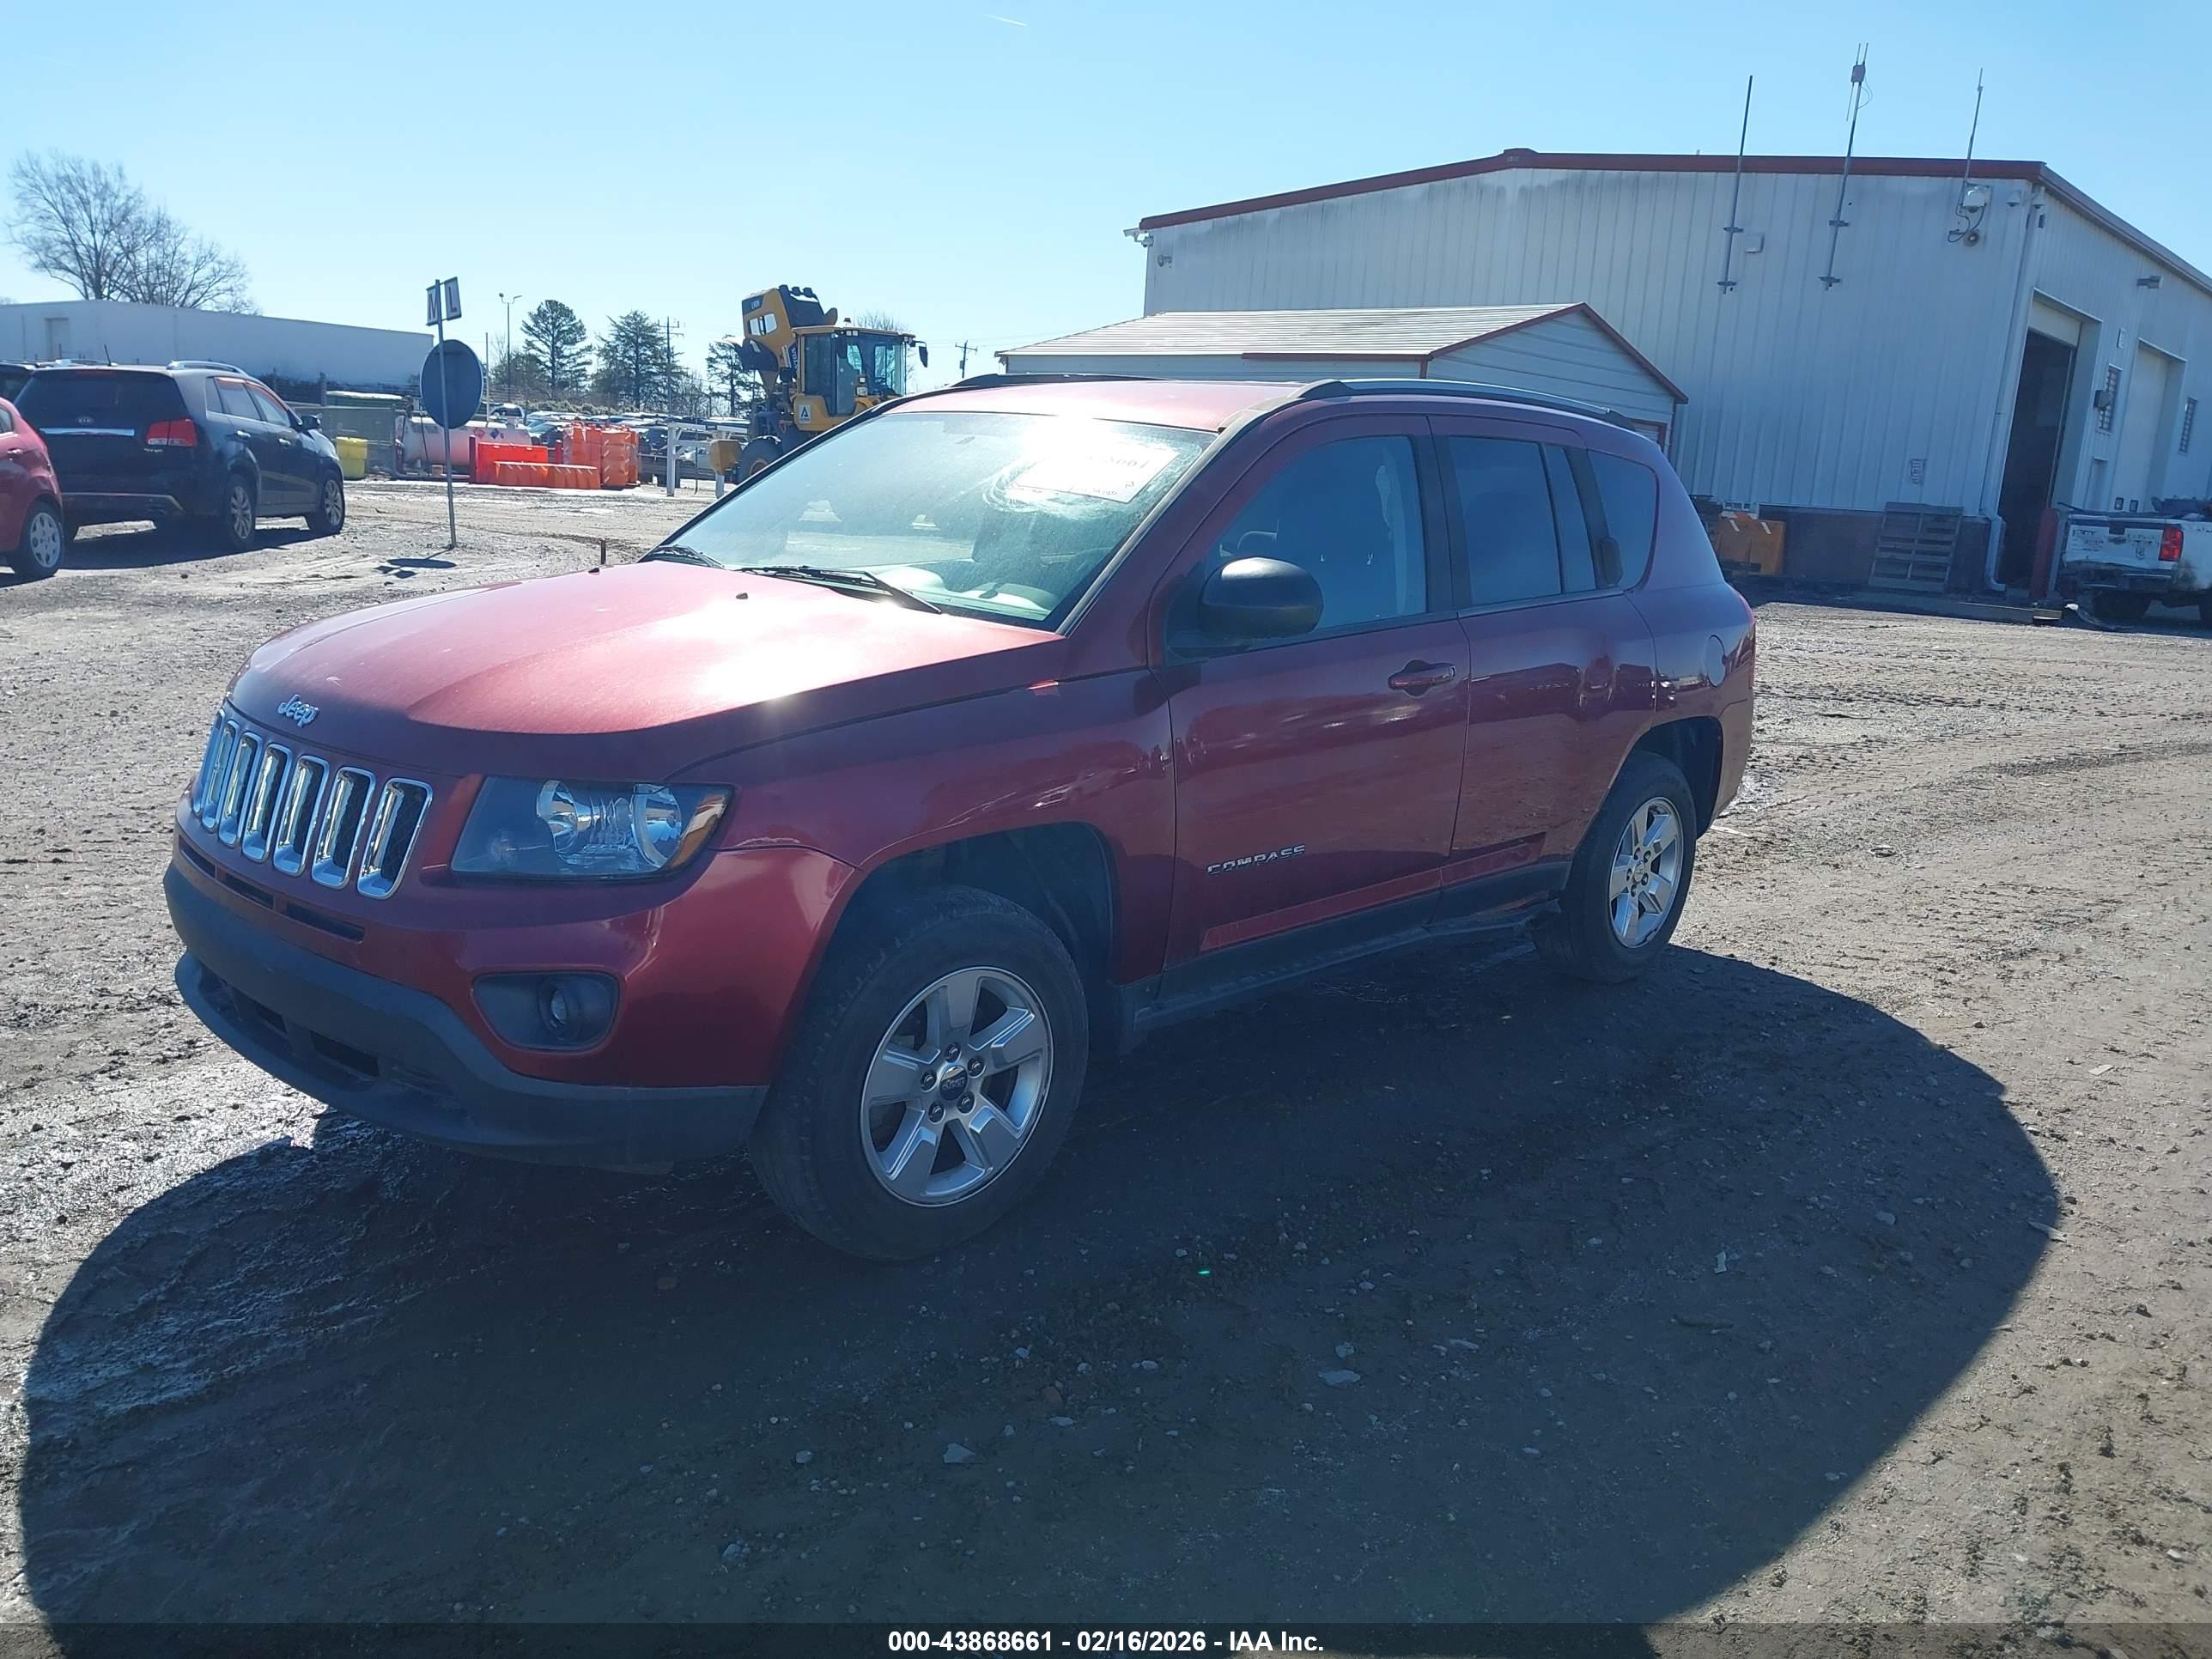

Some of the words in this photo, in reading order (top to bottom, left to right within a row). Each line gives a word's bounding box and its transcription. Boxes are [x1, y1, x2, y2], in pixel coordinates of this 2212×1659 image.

[448, 286, 457, 313] L
[276, 694, 319, 728] Jeep
[1206, 843, 1306, 875] COMPASS
